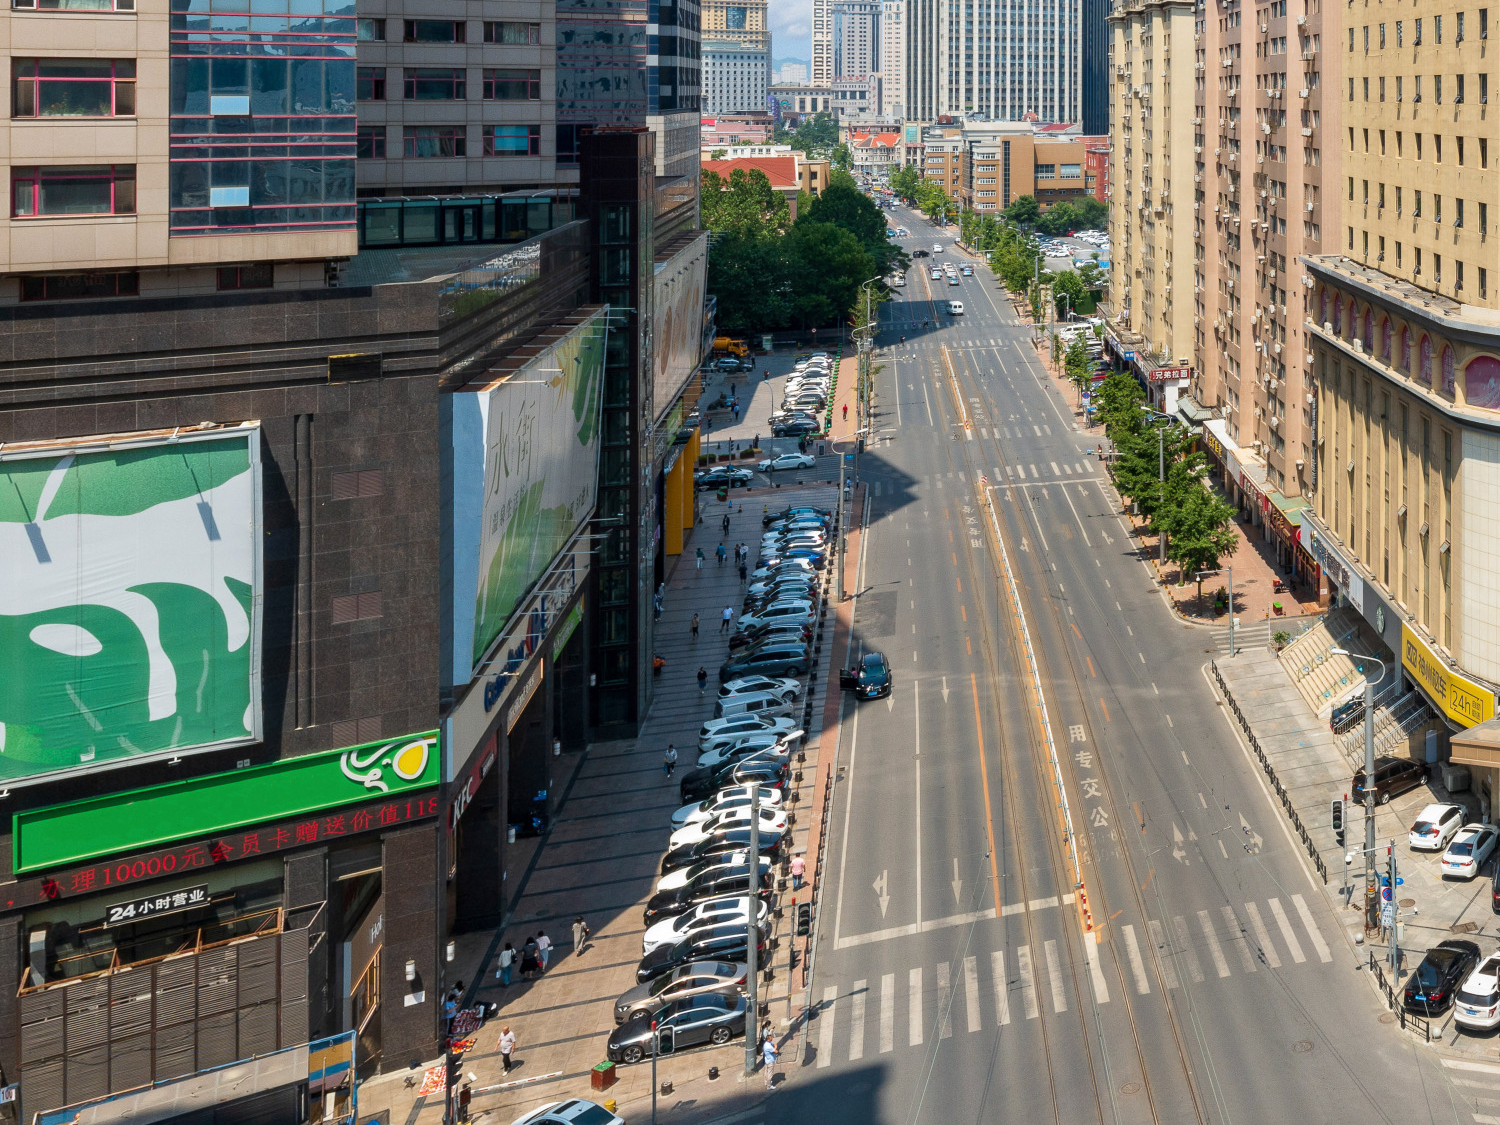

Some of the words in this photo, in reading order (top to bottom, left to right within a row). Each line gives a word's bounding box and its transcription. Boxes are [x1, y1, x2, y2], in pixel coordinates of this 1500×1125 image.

[1156, 369, 1188, 379] 兄弟拉面
[1452, 690, 1471, 715] 24h
[452, 776, 472, 829] KFC
[110, 889, 206, 923] 24小时营业
